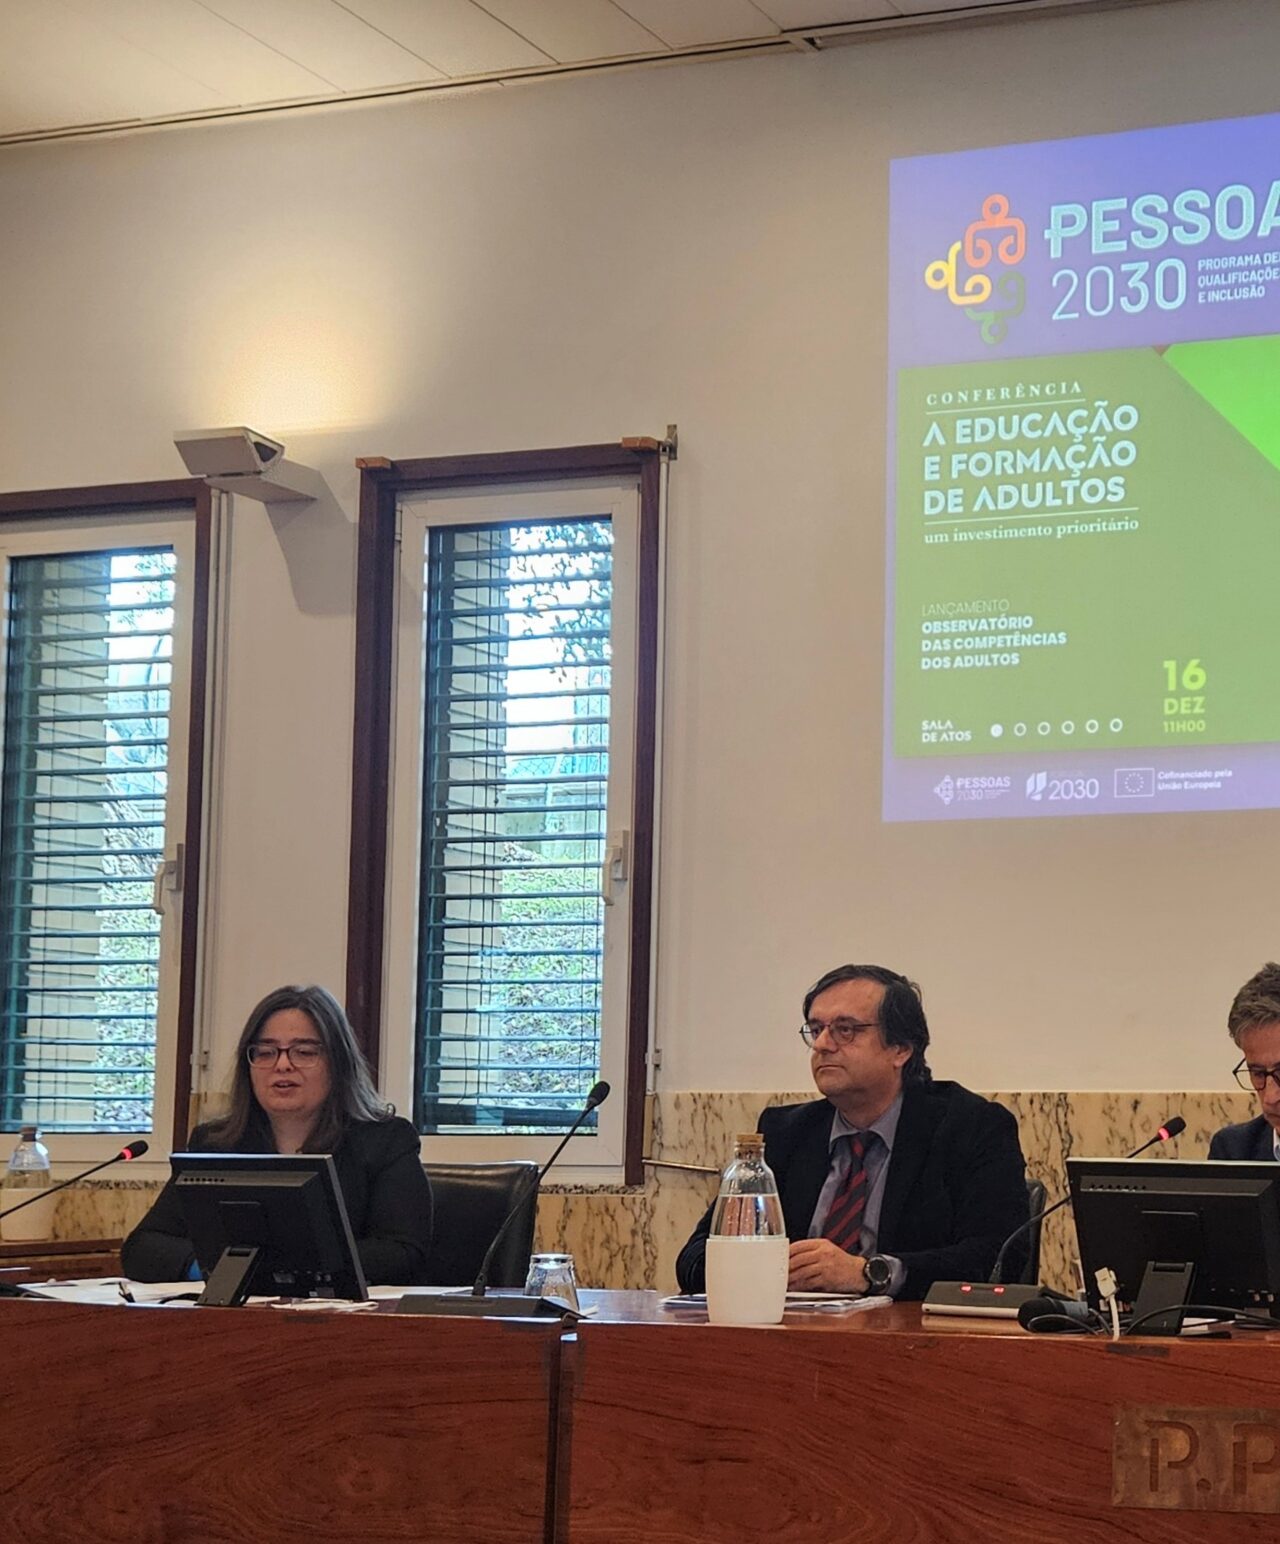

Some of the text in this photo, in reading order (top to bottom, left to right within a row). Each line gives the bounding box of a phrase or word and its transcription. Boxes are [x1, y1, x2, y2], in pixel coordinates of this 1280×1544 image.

[1198, 252, 1262, 272] PROGRAMA
[1051, 257, 1187, 321] 2030
[1198, 282, 1265, 303] E INCLUSÃO
[926, 380, 1082, 405] CONFERÊNCIA
[923, 401, 1139, 447] A EDUCAÇÃO
[925, 437, 1136, 480] E FORMAÇÃO
[924, 476, 1125, 515] DE ADULTOS
[924, 517, 1139, 544] um investimento prioritário
[922, 599, 1009, 618] LANÇAMENTO
[922, 613, 1033, 635] OBSERVATÓRIO
[922, 630, 1067, 652] DAS COMPETÊNCIAS
[921, 653, 1020, 670] DOS ADULTOS
[1163, 659, 1206, 691] 16
[1163, 697, 1205, 715] DEZ
[922, 720, 953, 731] SALA
[922, 730, 971, 742] DE ATOS
[1163, 719, 1206, 733] 11H00
[957, 776, 1010, 789] PESSOAS
[1158, 770, 1211, 781] Cofinanciado
[1158, 781, 1181, 791] União
[1049, 779, 1099, 800] 2030
